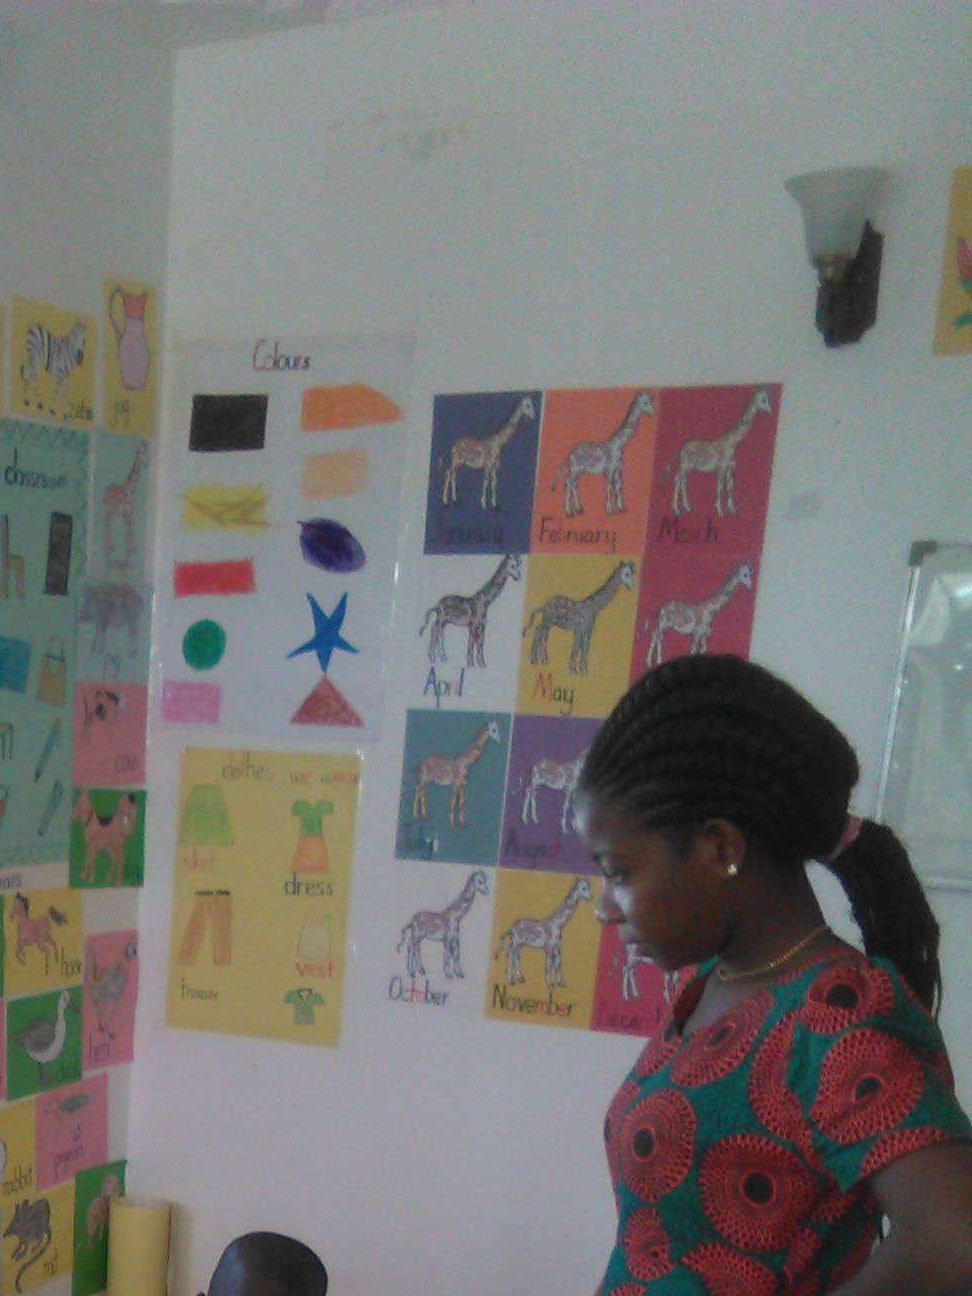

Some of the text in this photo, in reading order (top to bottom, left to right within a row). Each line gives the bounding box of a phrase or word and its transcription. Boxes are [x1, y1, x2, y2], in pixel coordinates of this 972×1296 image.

[423, 666, 465, 709] April
[532, 672, 574, 714] May
[284, 872, 335, 897] dress
[492, 982, 577, 1018] November
